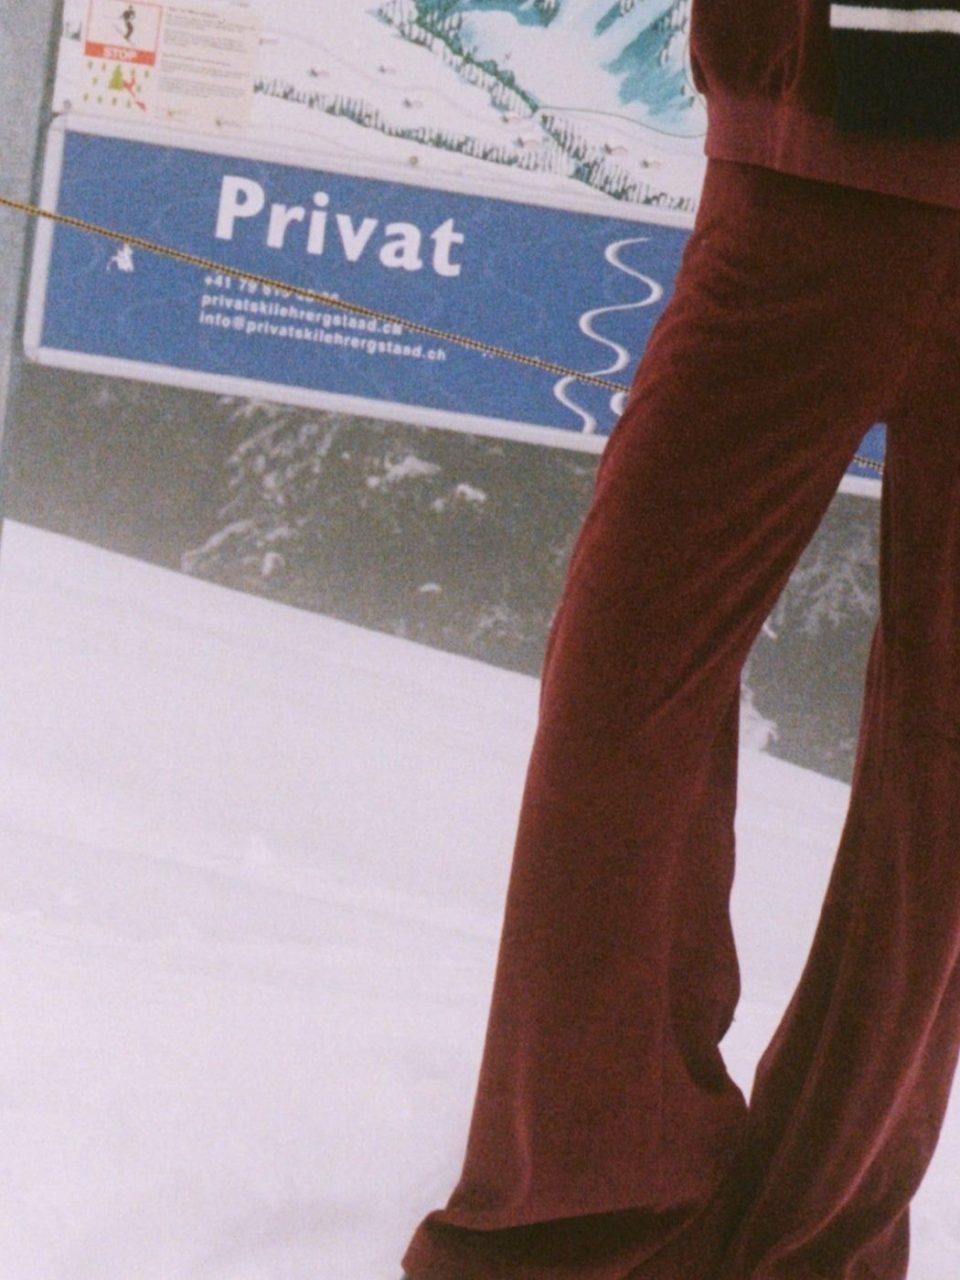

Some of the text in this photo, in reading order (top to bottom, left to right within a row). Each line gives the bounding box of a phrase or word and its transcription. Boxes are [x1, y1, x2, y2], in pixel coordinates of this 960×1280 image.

[102, 46, 135, 61] STOP
[214, 174, 464, 276] Privat
[198, 309, 447, 367] info@privatskilehrergstaad.ch
